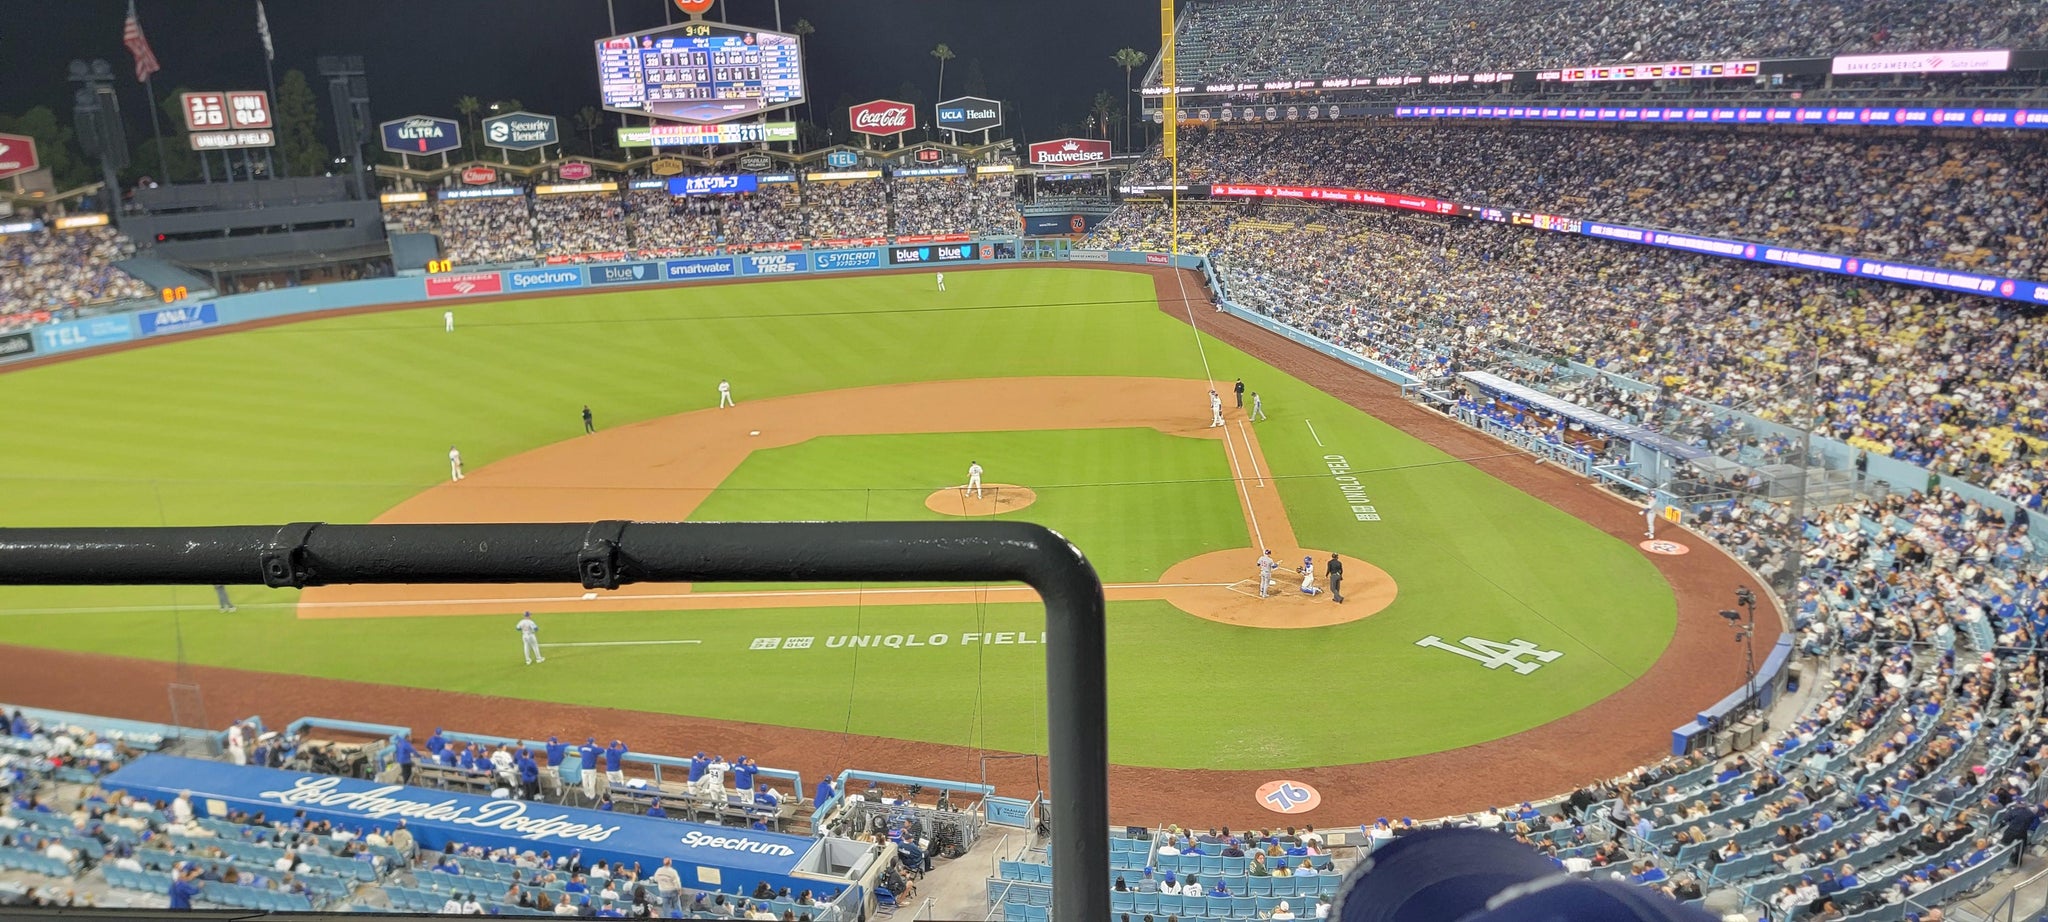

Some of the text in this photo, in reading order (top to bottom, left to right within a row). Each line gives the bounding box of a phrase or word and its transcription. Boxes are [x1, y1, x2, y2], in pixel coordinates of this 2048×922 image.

[686, 26, 710, 36] 9:04
[233, 96, 262, 110] UNI
[236, 109, 266, 125] QLO
[856, 107, 909, 128] Coca-Cola
[941, 109, 996, 120] UCLA Health
[510, 120, 550, 133] Security
[197, 132, 270, 147] UNIQLO FIELD
[398, 127, 444, 140] ULTRA
[513, 131, 547, 142] Benefit
[833, 153, 853, 164] TEL
[1074, 219, 1083, 227] 76
[830, 251, 876, 262] SYNCRON
[896, 250, 919, 259] blue
[938, 247, 961, 257] blue
[751, 255, 786, 266] TOYO
[605, 267, 632, 279] blue
[670, 263, 731, 275] smartwater
[757, 262, 796, 273] TIRES
[513, 273, 572, 288] Spectrum
[155, 308, 187, 325] ANA
[44, 326, 87, 348] TEL
[1323, 454, 1371, 503] UNIQLO FIELD
[825, 631, 1047, 649] UNIQLO FIEL
[1266, 782, 1313, 812] 76
[259, 776, 621, 843] Los Angeles Dodgers
[681, 830, 787, 857] Spectrum
